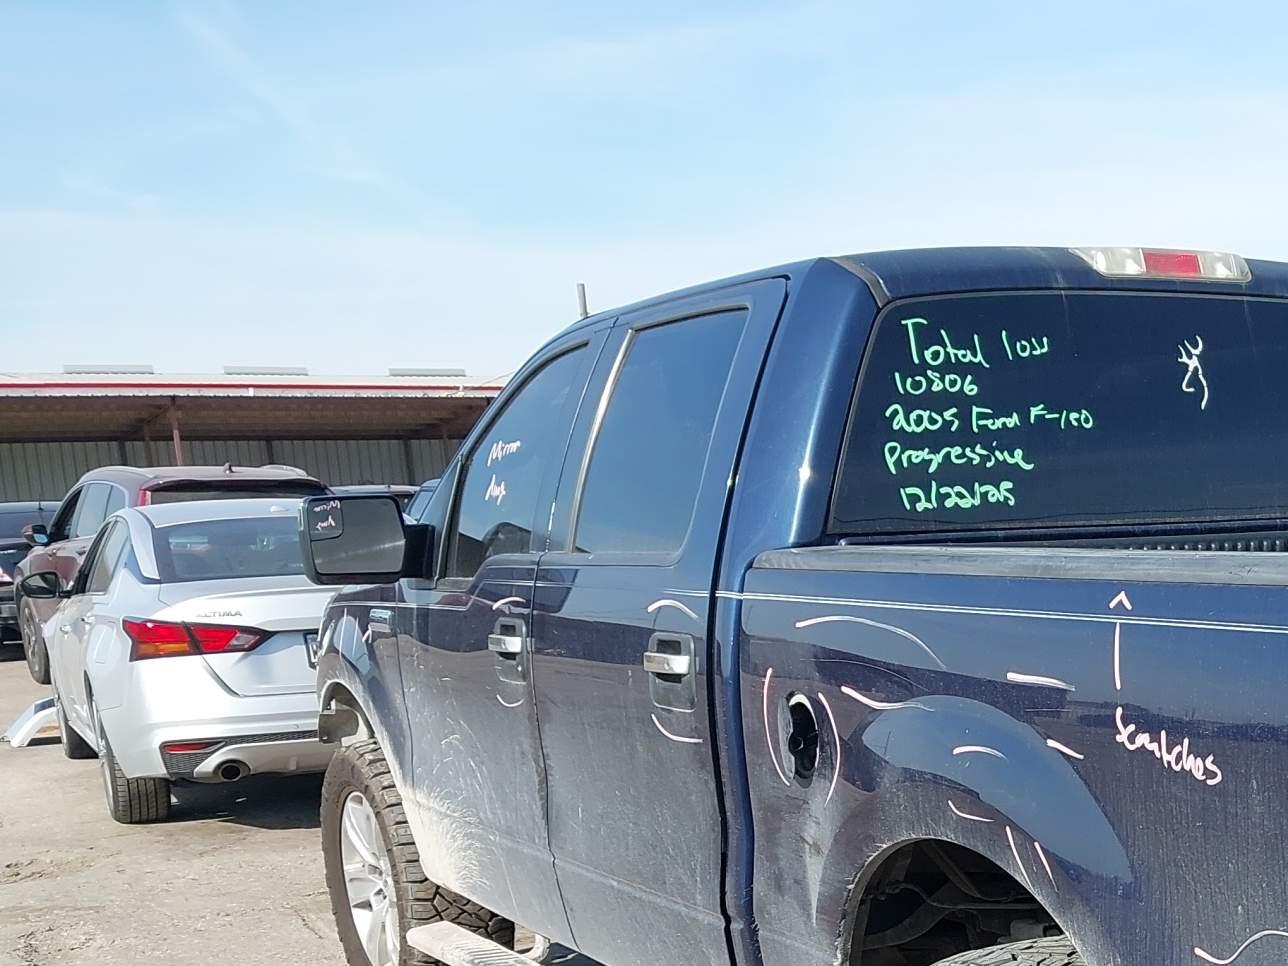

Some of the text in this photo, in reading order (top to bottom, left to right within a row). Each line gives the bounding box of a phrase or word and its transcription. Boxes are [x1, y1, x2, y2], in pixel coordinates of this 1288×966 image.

[901, 318, 1048, 367] Total loss
[895, 370, 977, 395] 10806
[886, 404, 959, 432] 2005
[972, 406, 1020, 432] Ford
[885, 442, 1034, 474] Progressive
[900, 481, 1015, 512] 12/22/25
